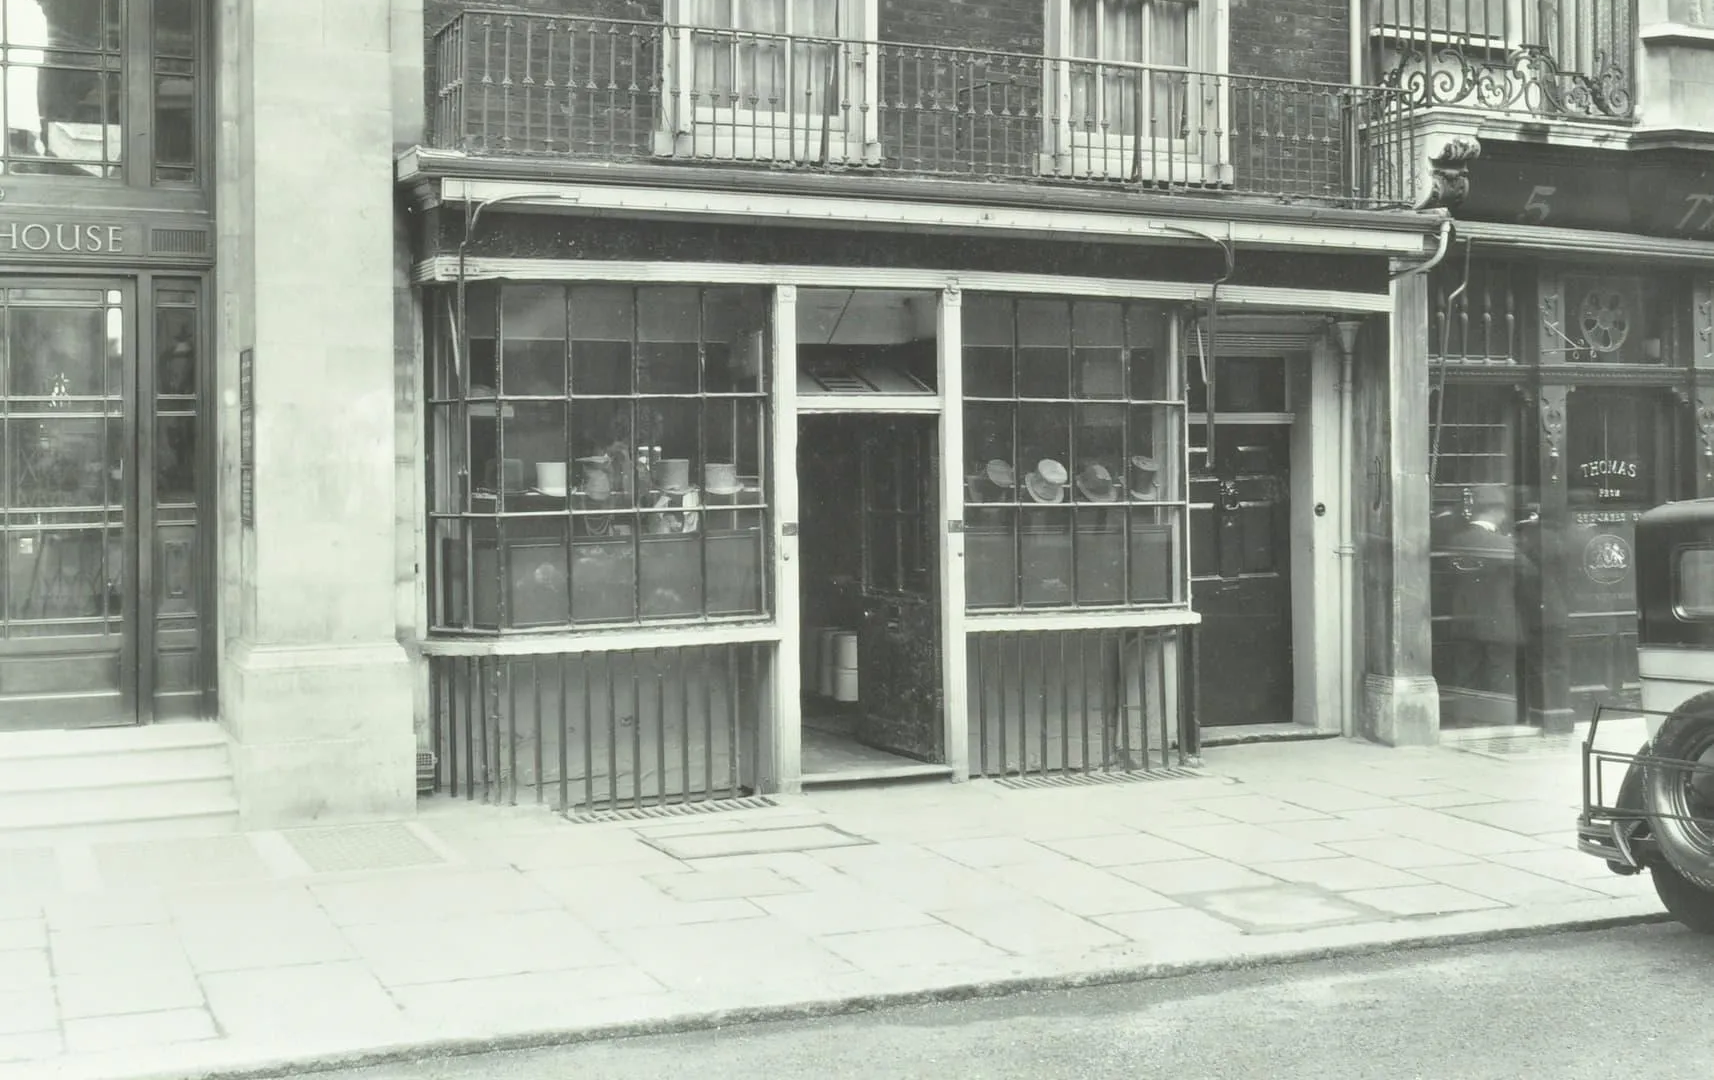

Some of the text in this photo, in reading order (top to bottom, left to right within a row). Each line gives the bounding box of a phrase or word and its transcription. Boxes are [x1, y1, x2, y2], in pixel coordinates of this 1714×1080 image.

[1516, 185, 1557, 224] 5
[0, 223, 123, 252] HOUSE
[1580, 460, 1637, 478] THOMAS
